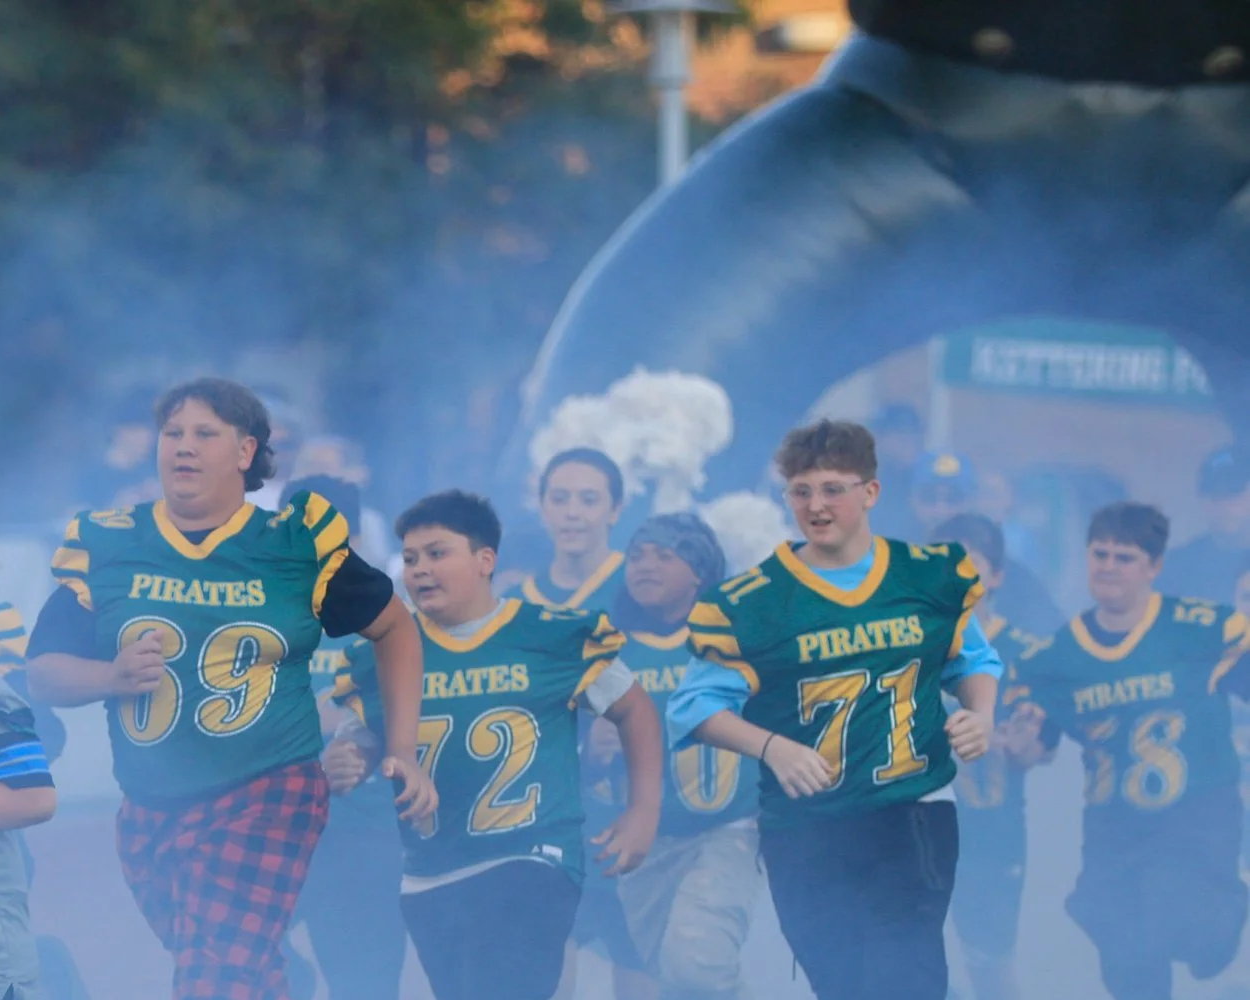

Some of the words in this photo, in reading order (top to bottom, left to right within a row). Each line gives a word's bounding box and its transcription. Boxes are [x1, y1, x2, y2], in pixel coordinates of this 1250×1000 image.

[129, 574, 266, 606] PIRATES
[796, 615, 924, 663] PIRATES
[117, 615, 288, 746] 69
[422, 663, 530, 699] RATES
[798, 658, 928, 791] 71
